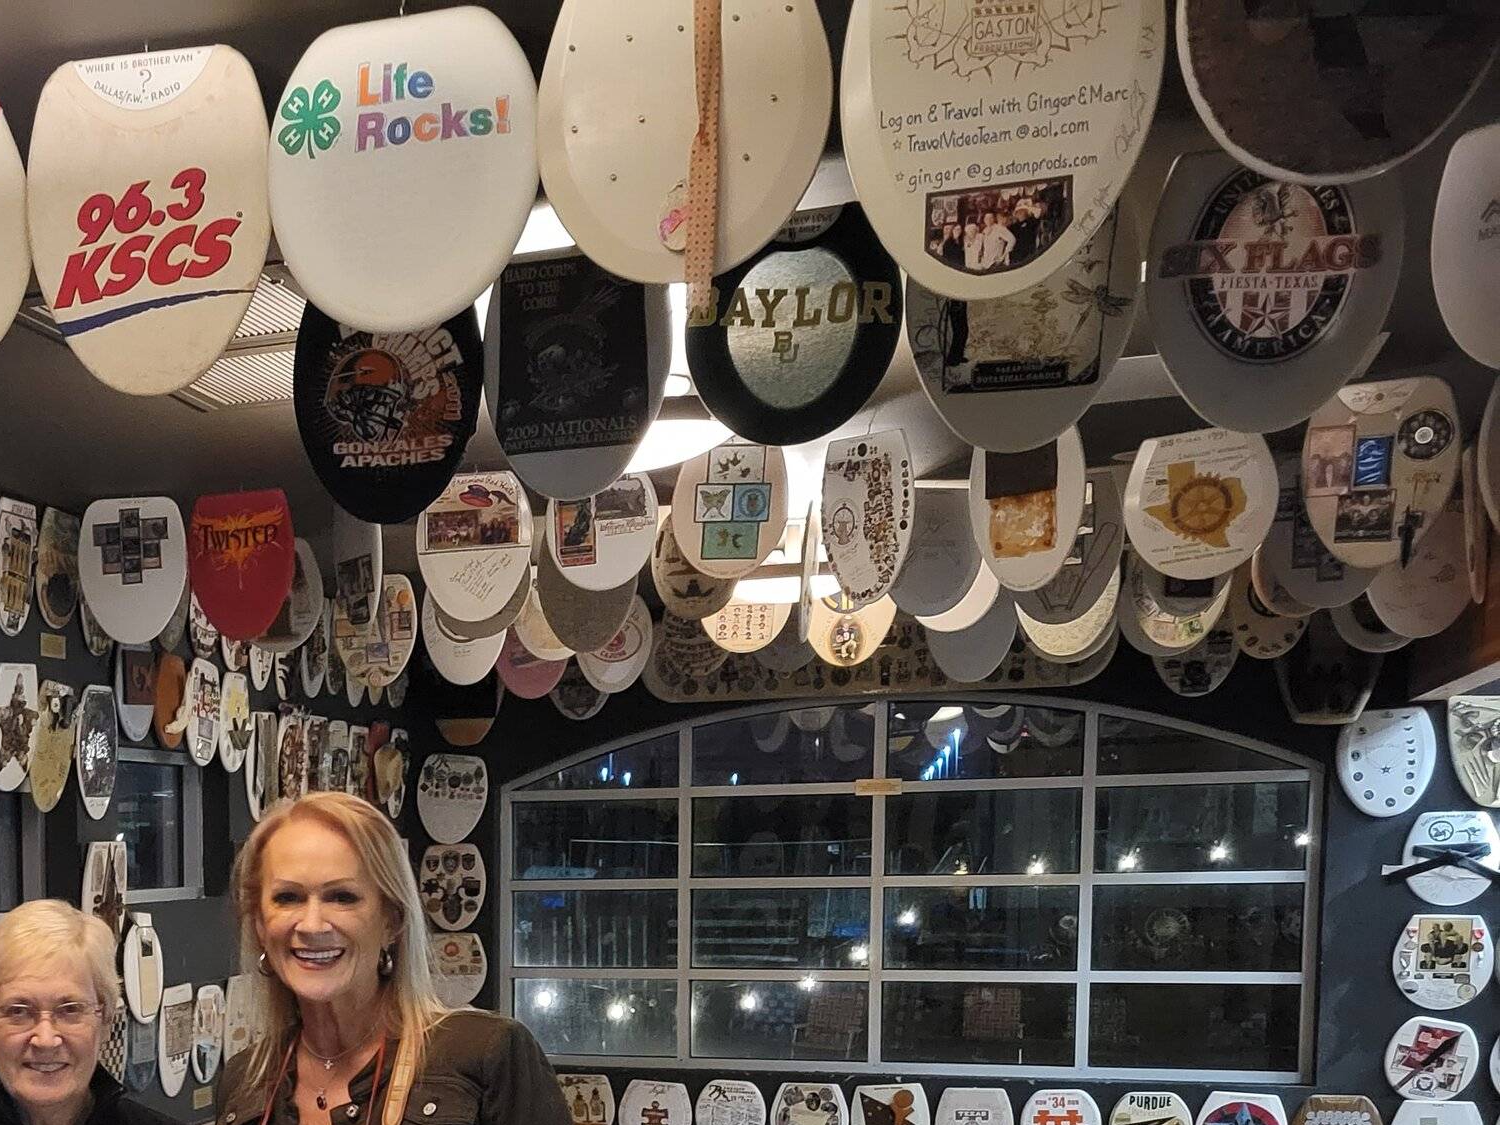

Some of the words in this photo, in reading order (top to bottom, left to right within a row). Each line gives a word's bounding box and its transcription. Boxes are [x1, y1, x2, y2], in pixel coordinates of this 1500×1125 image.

[974, 16, 1037, 40] GASTON
[120, 57, 129, 69] IS
[132, 55, 171, 69] BROTHER
[150, 82, 181, 102] RADIO
[356, 61, 435, 106] Life
[288, 97, 305, 114] H
[318, 90, 335, 109] H
[355, 95, 511, 152] Rocks!
[879, 110, 903, 133] Log
[906, 112, 923, 126] on
[943, 98, 984, 121] Travel
[988, 97, 1023, 116] with
[285, 128, 301, 147] H
[319, 123, 334, 142] H
[77, 167, 207, 247] 96.3
[53, 217, 243, 309] KSCS
[1241, 232, 1384, 275] FLAGS
[1220, 275, 1268, 290] FIESTA
[1275, 274, 1320, 289] TEXAS
[687, 280, 894, 329] BAYLOR
[1217, 312, 1327, 356] AMERICA
[505, 424, 540, 442] 2009
[541, 415, 638, 438] NATIONALS
[332, 433, 454, 455] GONZALES
[339, 448, 446, 468] APACHES
[1129, 1095, 1172, 1111] PURDUE
